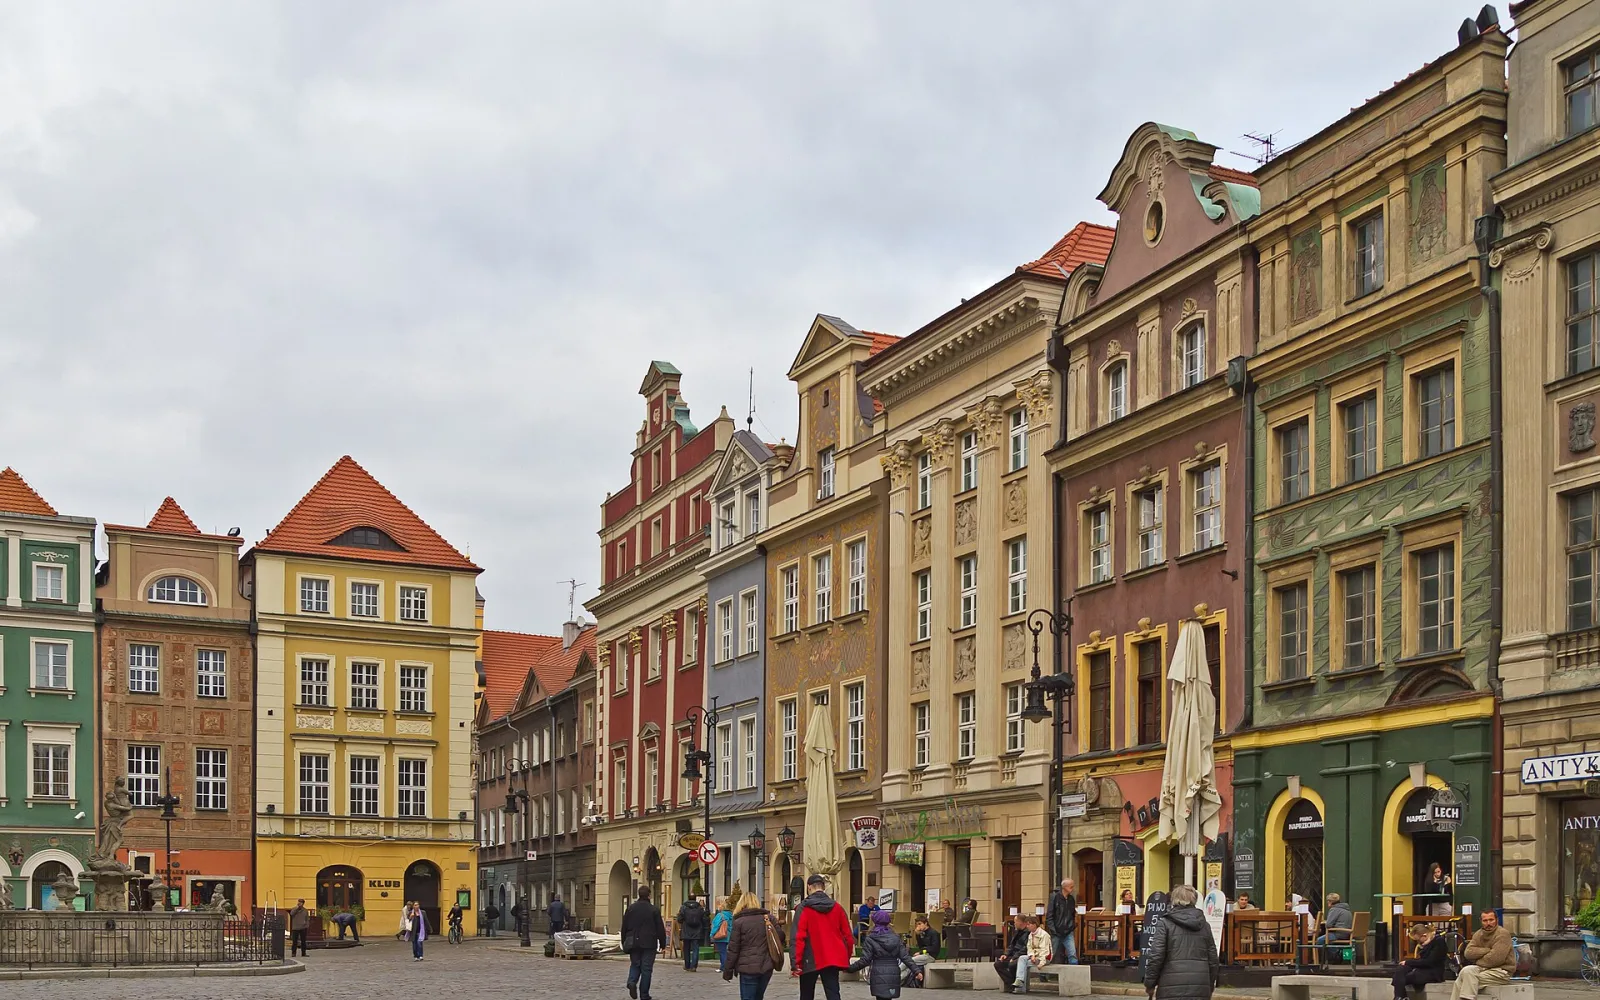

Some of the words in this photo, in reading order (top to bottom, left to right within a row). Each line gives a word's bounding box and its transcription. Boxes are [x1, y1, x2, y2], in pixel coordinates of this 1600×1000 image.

[1435, 807, 1459, 818] LECH
[1456, 843, 1479, 852] ANTYKI
[369, 880, 400, 888] KLUB
[1147, 902, 1166, 912] PIWO
